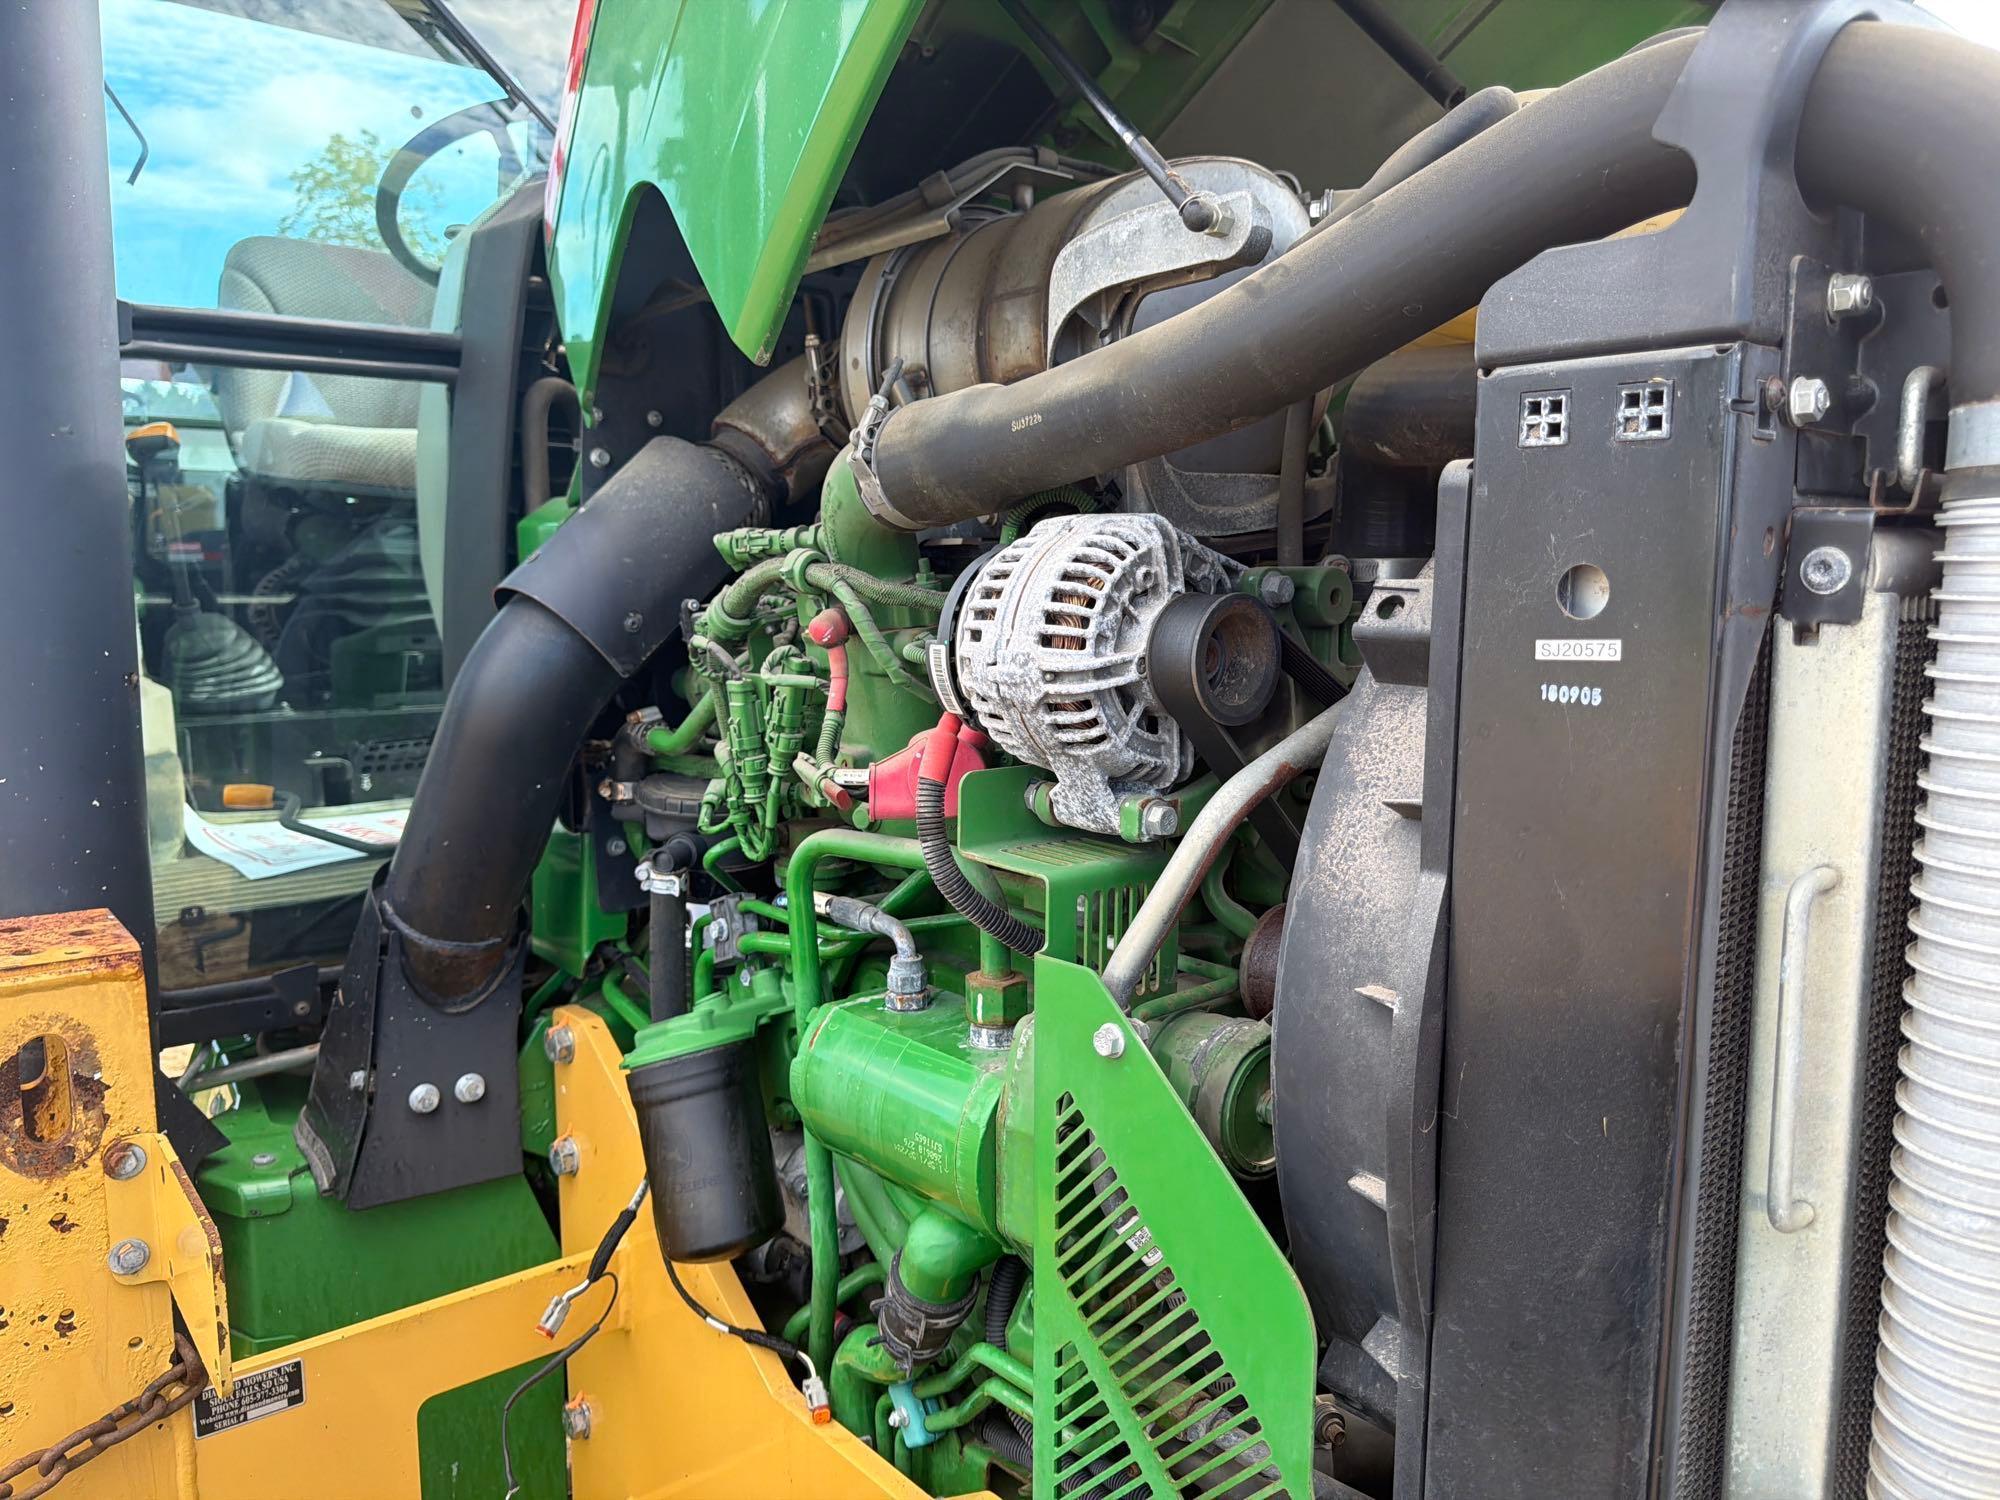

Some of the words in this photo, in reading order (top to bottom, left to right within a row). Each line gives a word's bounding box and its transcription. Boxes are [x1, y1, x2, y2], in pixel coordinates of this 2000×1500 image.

[1541, 643, 1617, 657] SJ20575
[202, 1381, 241, 1401] DIAD
[242, 1368, 281, 1388] MOWERS,
[280, 1363, 297, 1375] INC.
[262, 1380, 273, 1390] SD
[274, 1375, 289, 1387] USA
[211, 1400, 240, 1416] PHONE
[240, 1384, 288, 1406] 605-977-3300
[199, 1412, 225, 1426] Website
[214, 1416, 239, 1431] SERIAL
